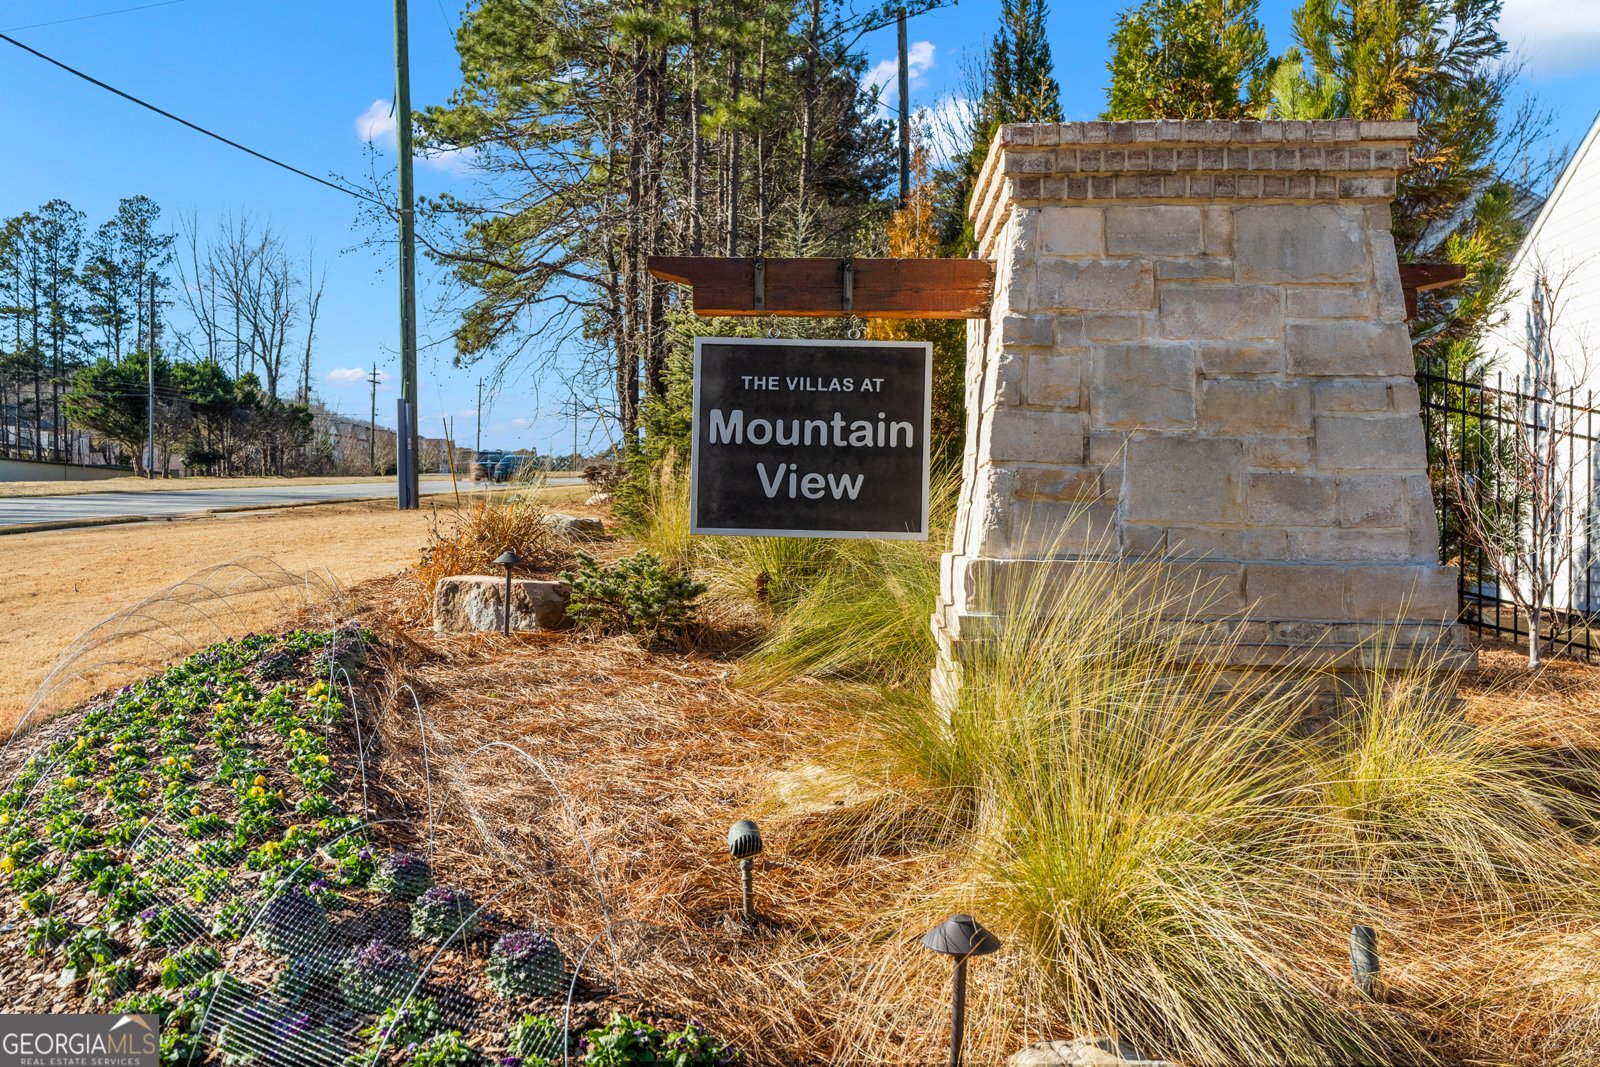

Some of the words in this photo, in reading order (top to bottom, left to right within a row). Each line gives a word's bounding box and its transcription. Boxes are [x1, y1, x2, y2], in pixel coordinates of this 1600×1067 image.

[741, 375, 780, 391] THE
[785, 376, 854, 392] VILLAS
[860, 378, 885, 392] AT
[708, 408, 914, 448] Mountain
[755, 462, 865, 500] View
